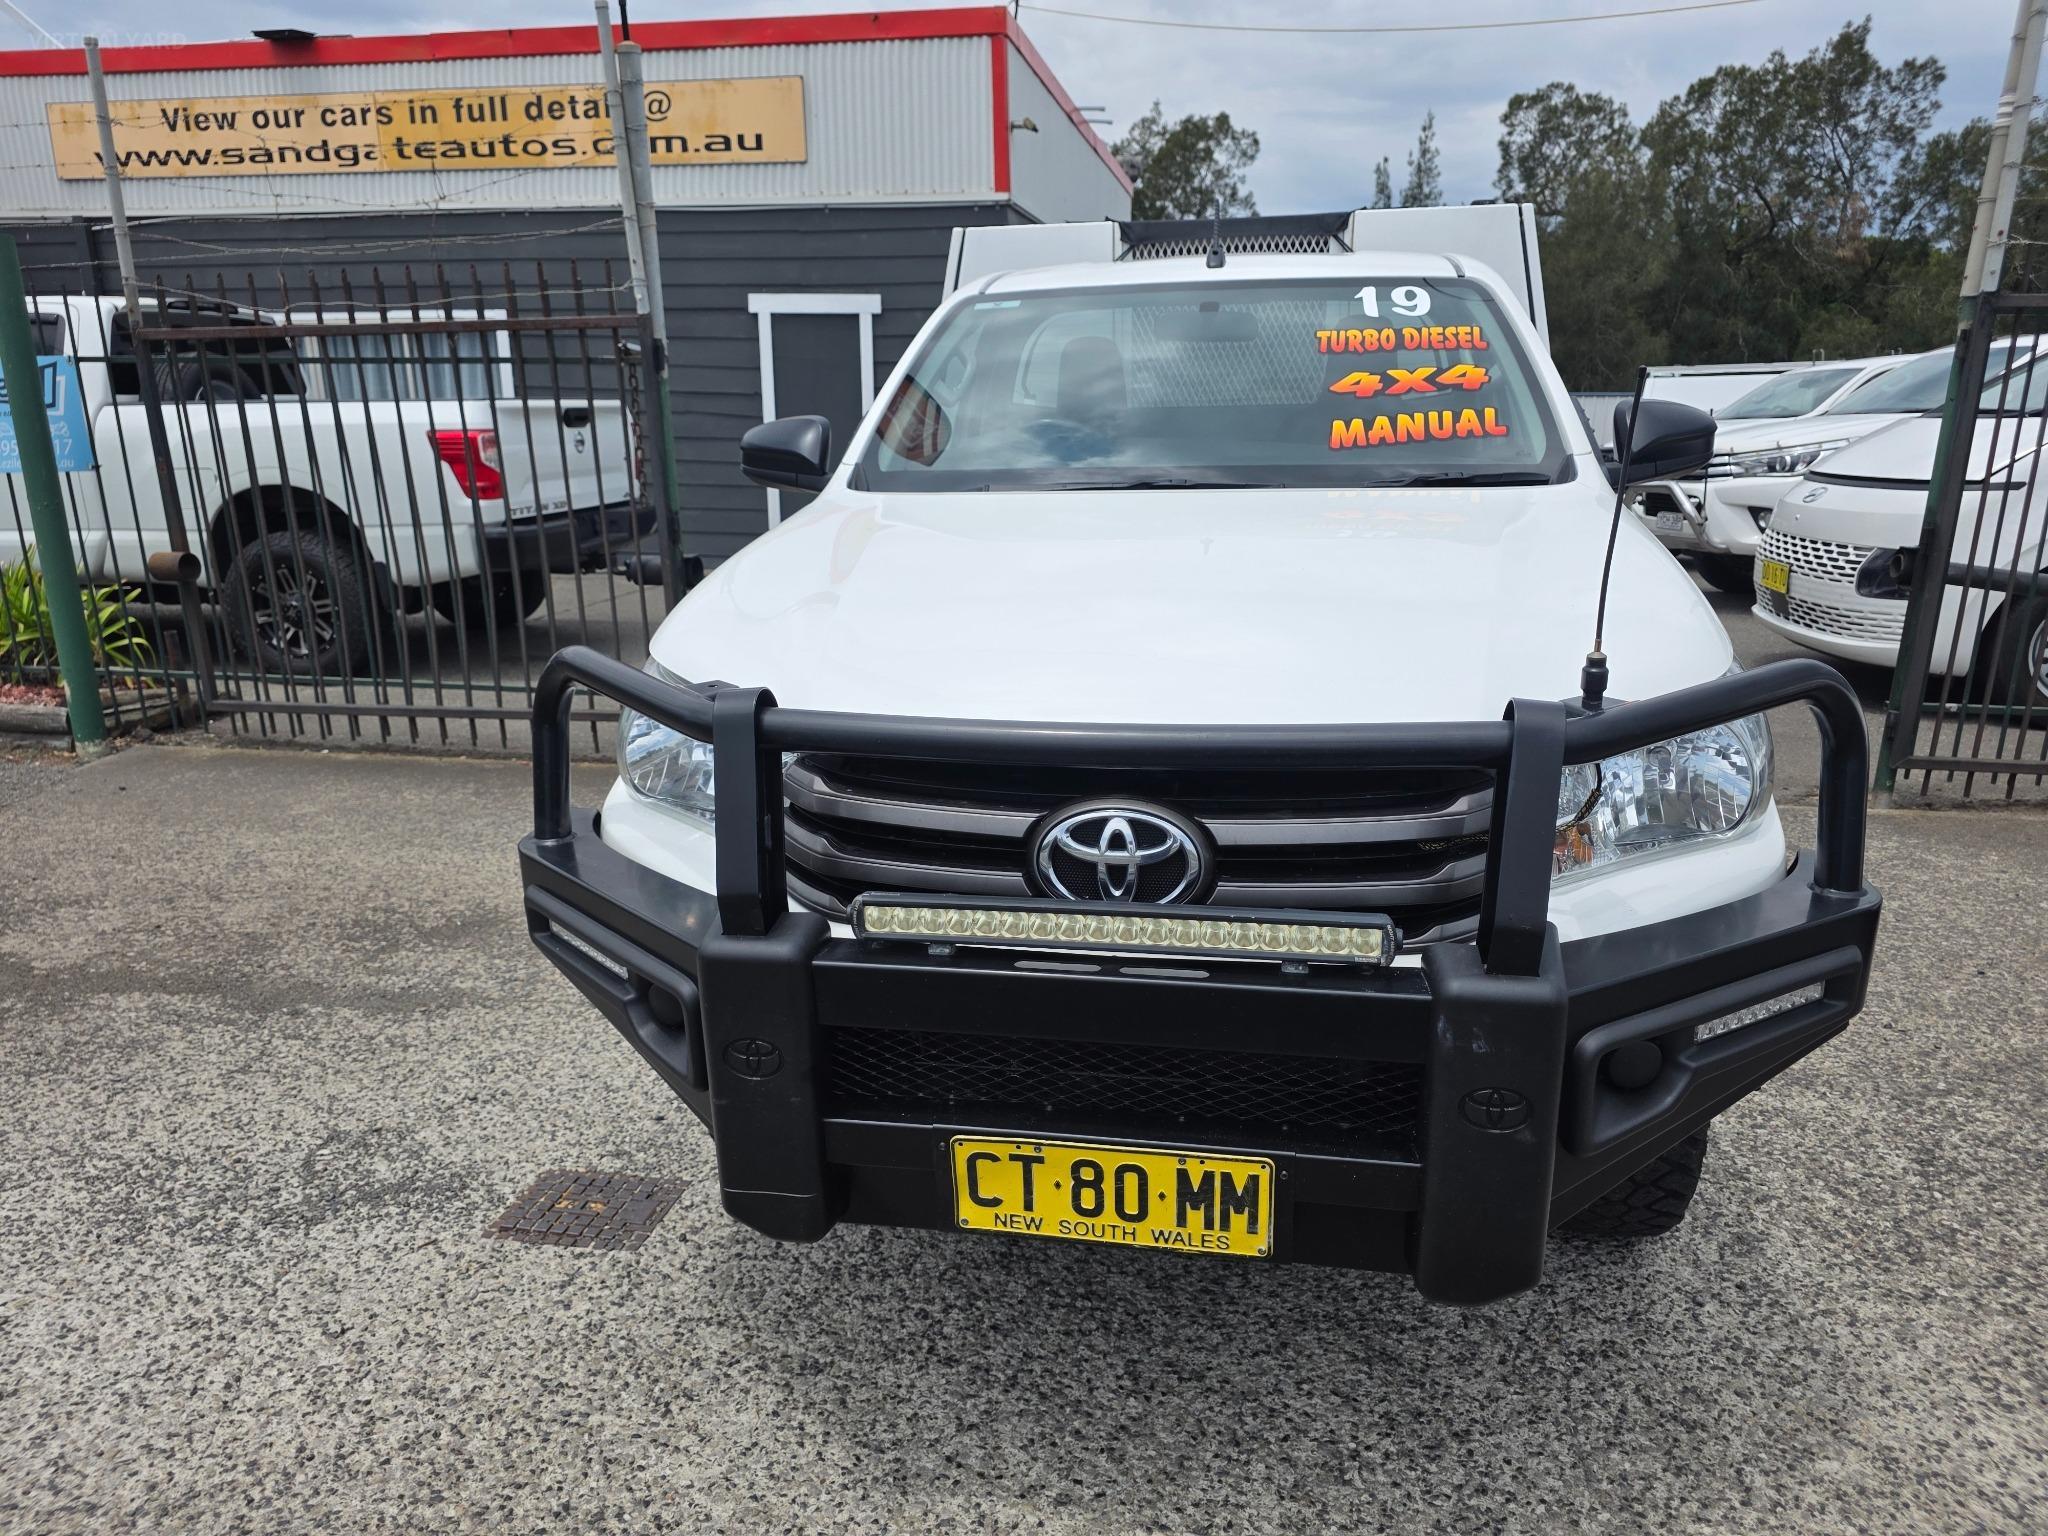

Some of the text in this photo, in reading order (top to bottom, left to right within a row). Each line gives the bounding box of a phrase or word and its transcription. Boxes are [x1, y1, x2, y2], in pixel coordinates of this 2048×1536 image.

[160, 90, 672, 132] View our cars in full detai @
[94, 132, 764, 168] www.sandgateautos.cm.au
[1354, 286, 1431, 318] 19
[1315, 325, 1489, 354] TURBO DIESEL
[1329, 406, 1508, 450] MANUAL
[993, 1212, 1231, 1251] NEW SOUTH WALES
